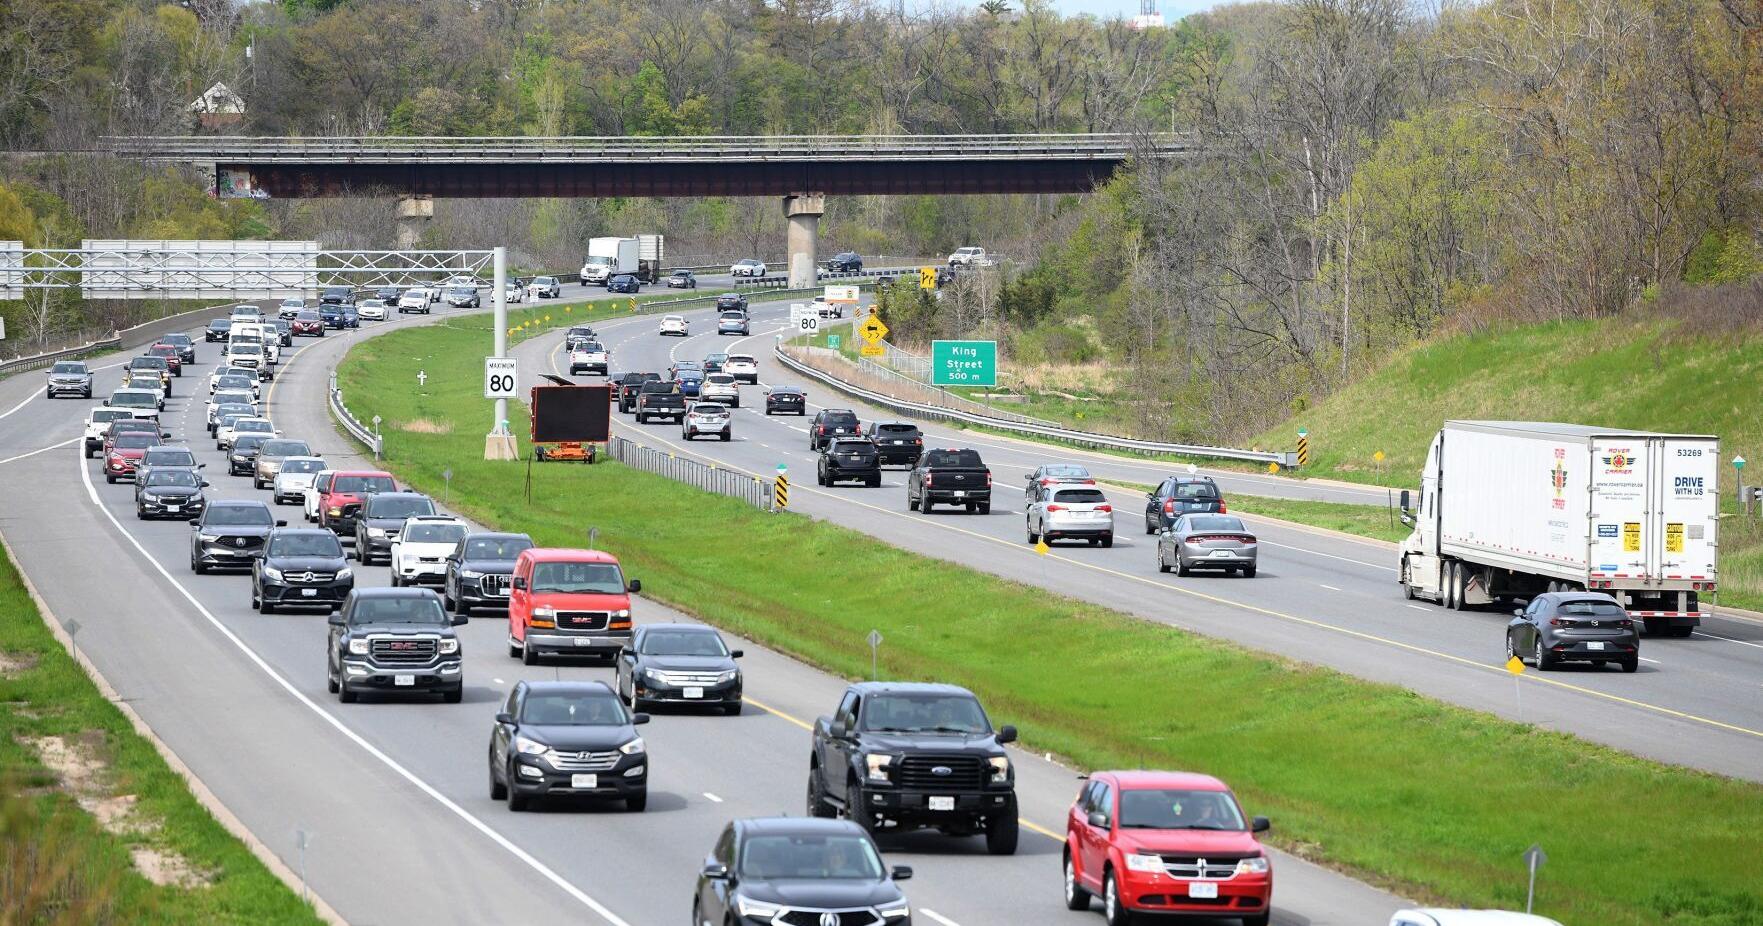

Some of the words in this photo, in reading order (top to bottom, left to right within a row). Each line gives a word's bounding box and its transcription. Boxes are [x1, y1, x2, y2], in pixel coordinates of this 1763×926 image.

[801, 318, 817, 329] 80
[952, 346, 977, 357] King
[946, 360, 983, 368] Street
[948, 372, 968, 380] 500
[490, 374, 514, 392] 80
[1677, 449, 1702, 457] 53269
[1674, 476, 1704, 488] DRIVE
[1674, 488, 1693, 496] WITH
[1694, 488, 1704, 496] US
[390, 642, 418, 650] GMC
